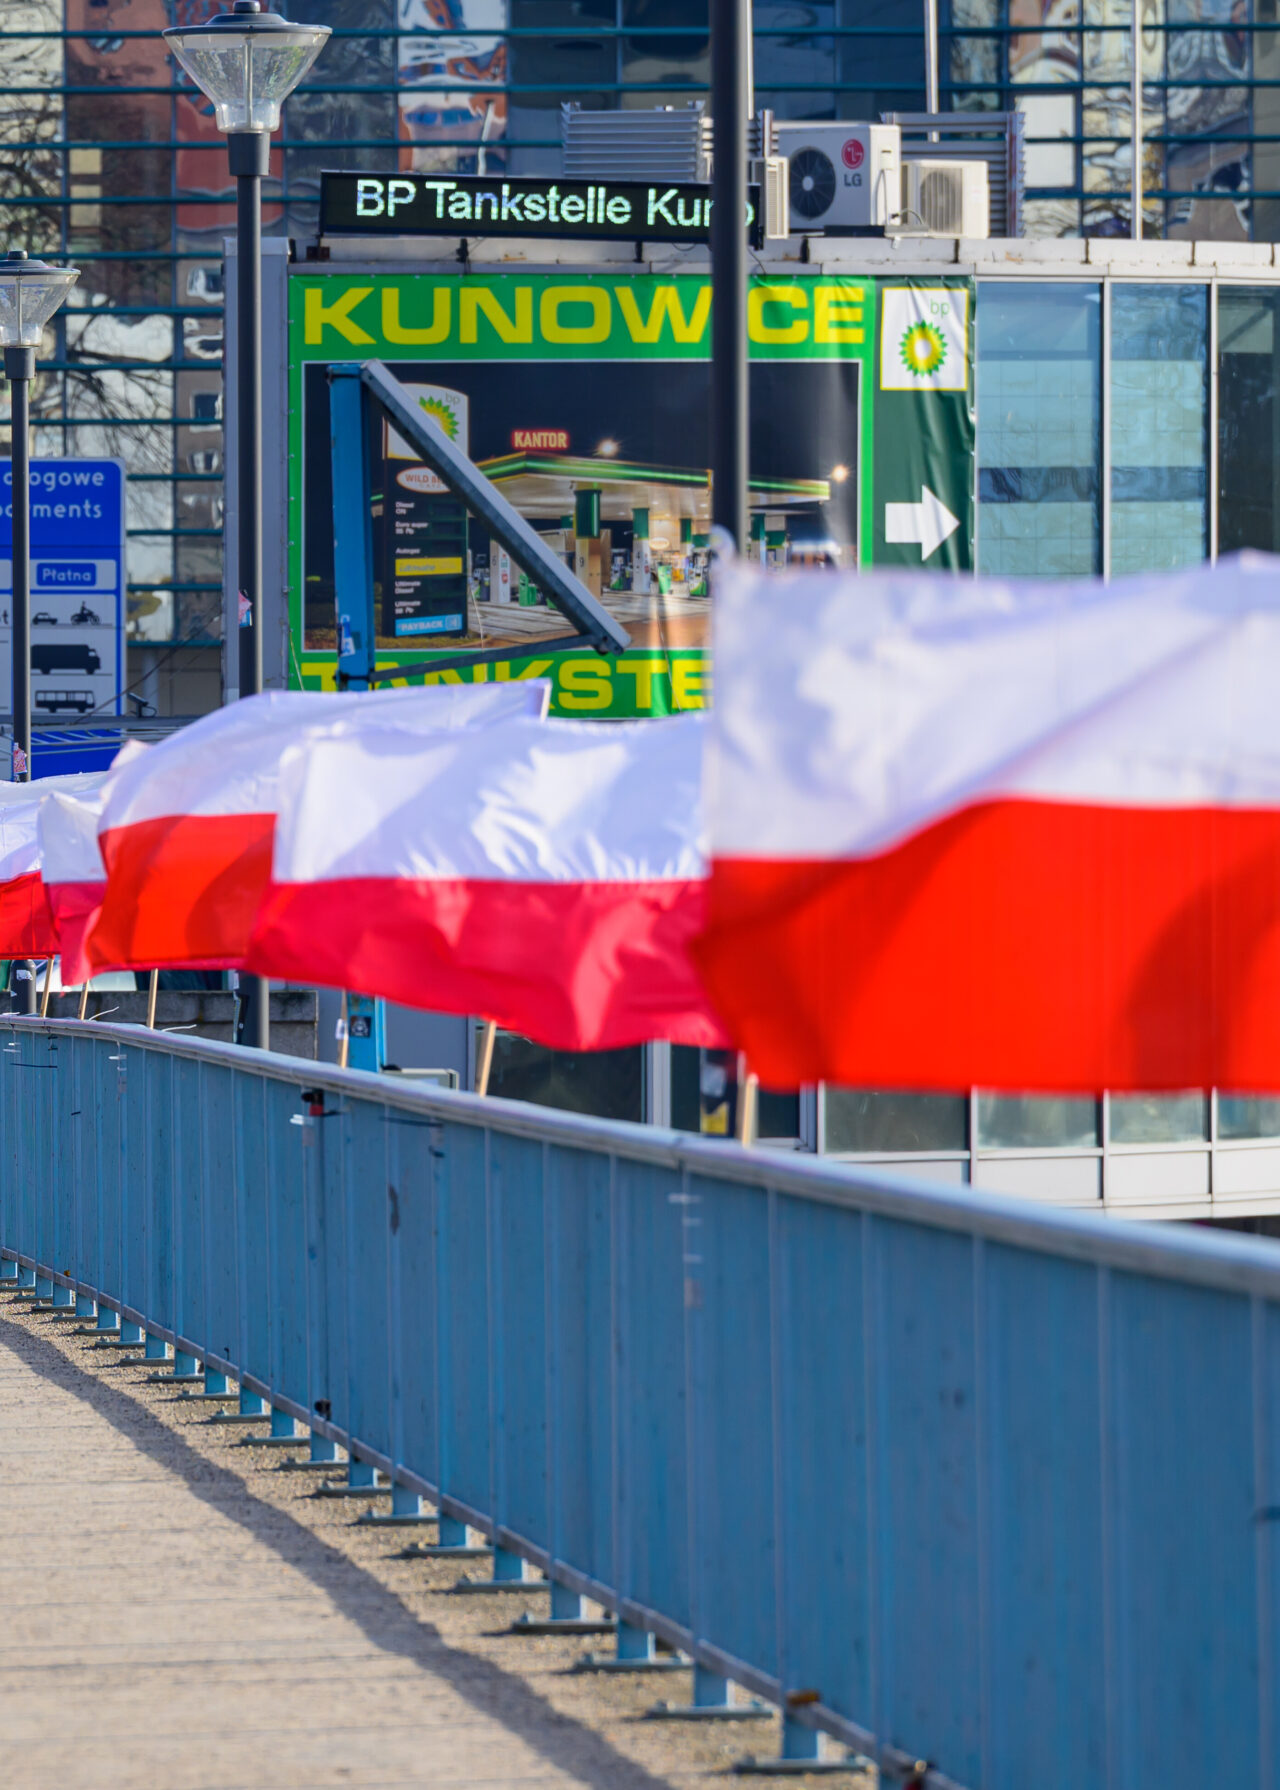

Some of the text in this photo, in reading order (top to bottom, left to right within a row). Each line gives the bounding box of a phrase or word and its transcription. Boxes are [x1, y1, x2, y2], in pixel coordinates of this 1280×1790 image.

[844, 173, 862, 187] LG
[356, 179, 417, 217] BP
[426, 181, 632, 225] Tankstelle
[304, 285, 865, 345] KUNOWCE
[930, 299, 950, 317] bp
[514, 431, 568, 449] KANTOR
[42, 568, 92, 582] Płatna
